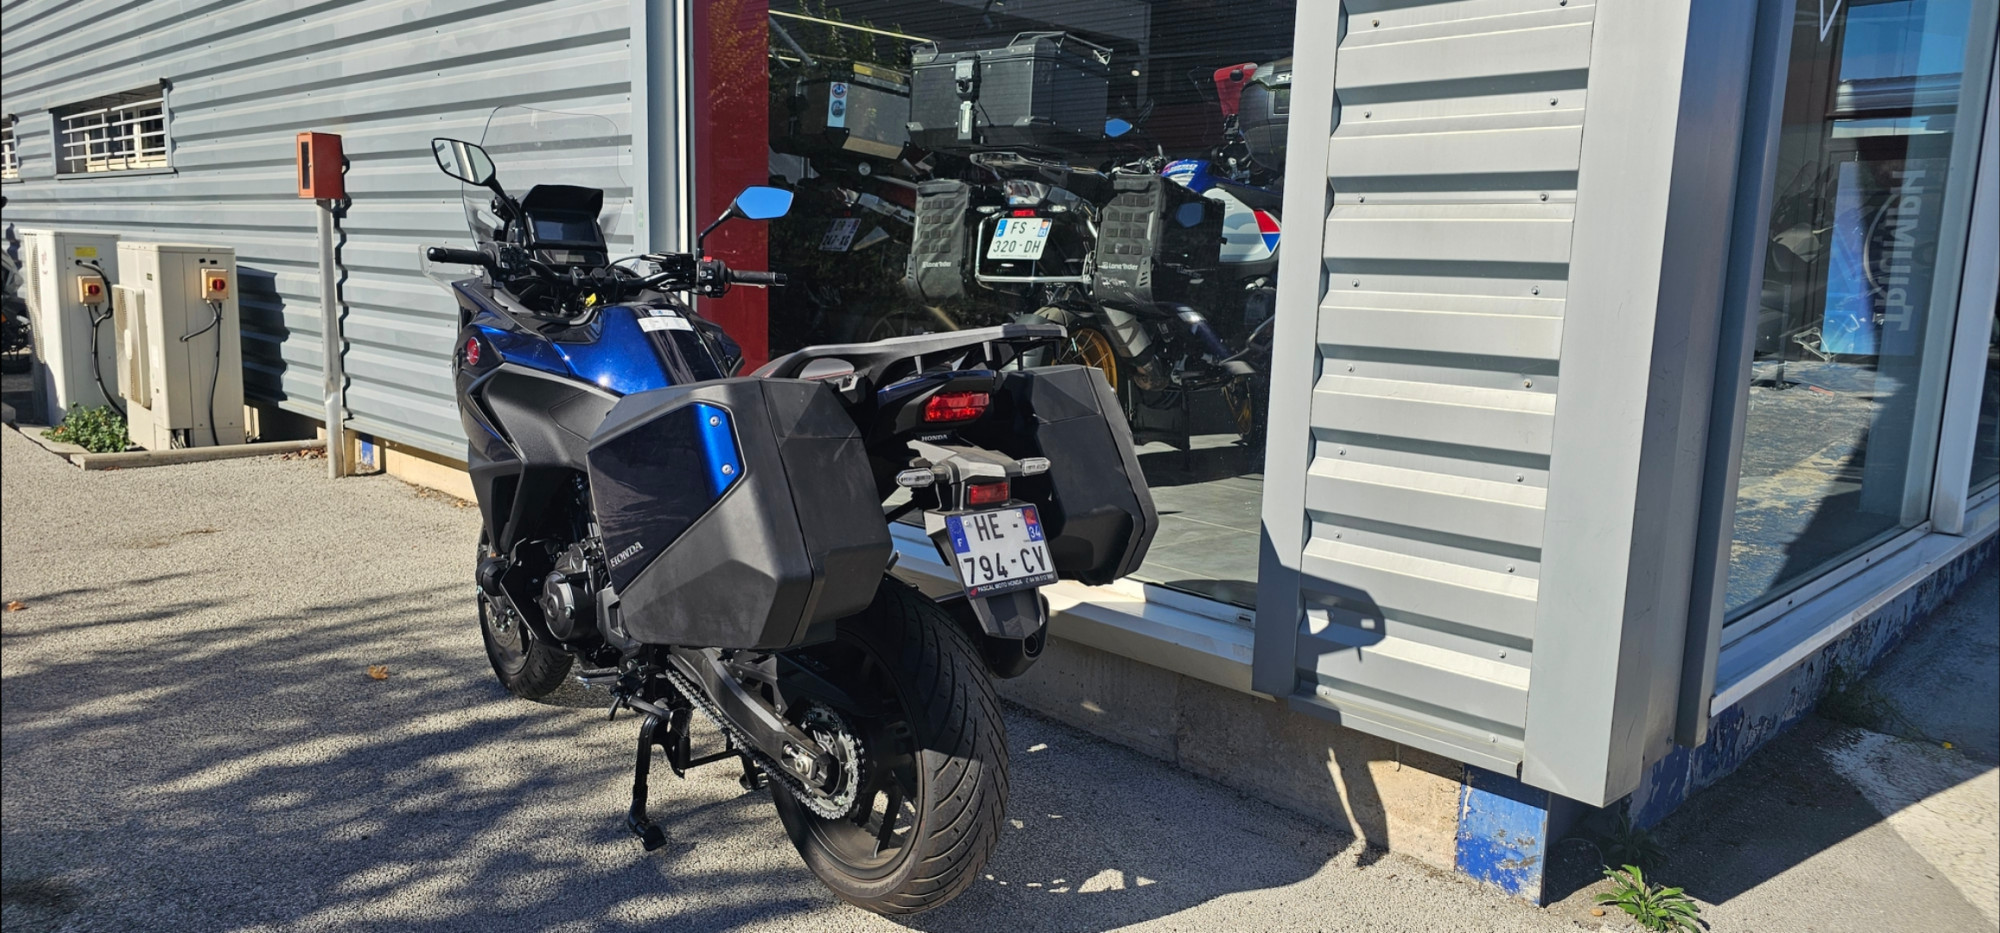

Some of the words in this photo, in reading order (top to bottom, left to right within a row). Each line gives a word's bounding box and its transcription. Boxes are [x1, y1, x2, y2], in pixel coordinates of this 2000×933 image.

[921, 434, 948, 442] HONDA
[1029, 526, 1041, 538] 34
[957, 538, 963, 547] F
[610, 541, 644, 567] HONDA
